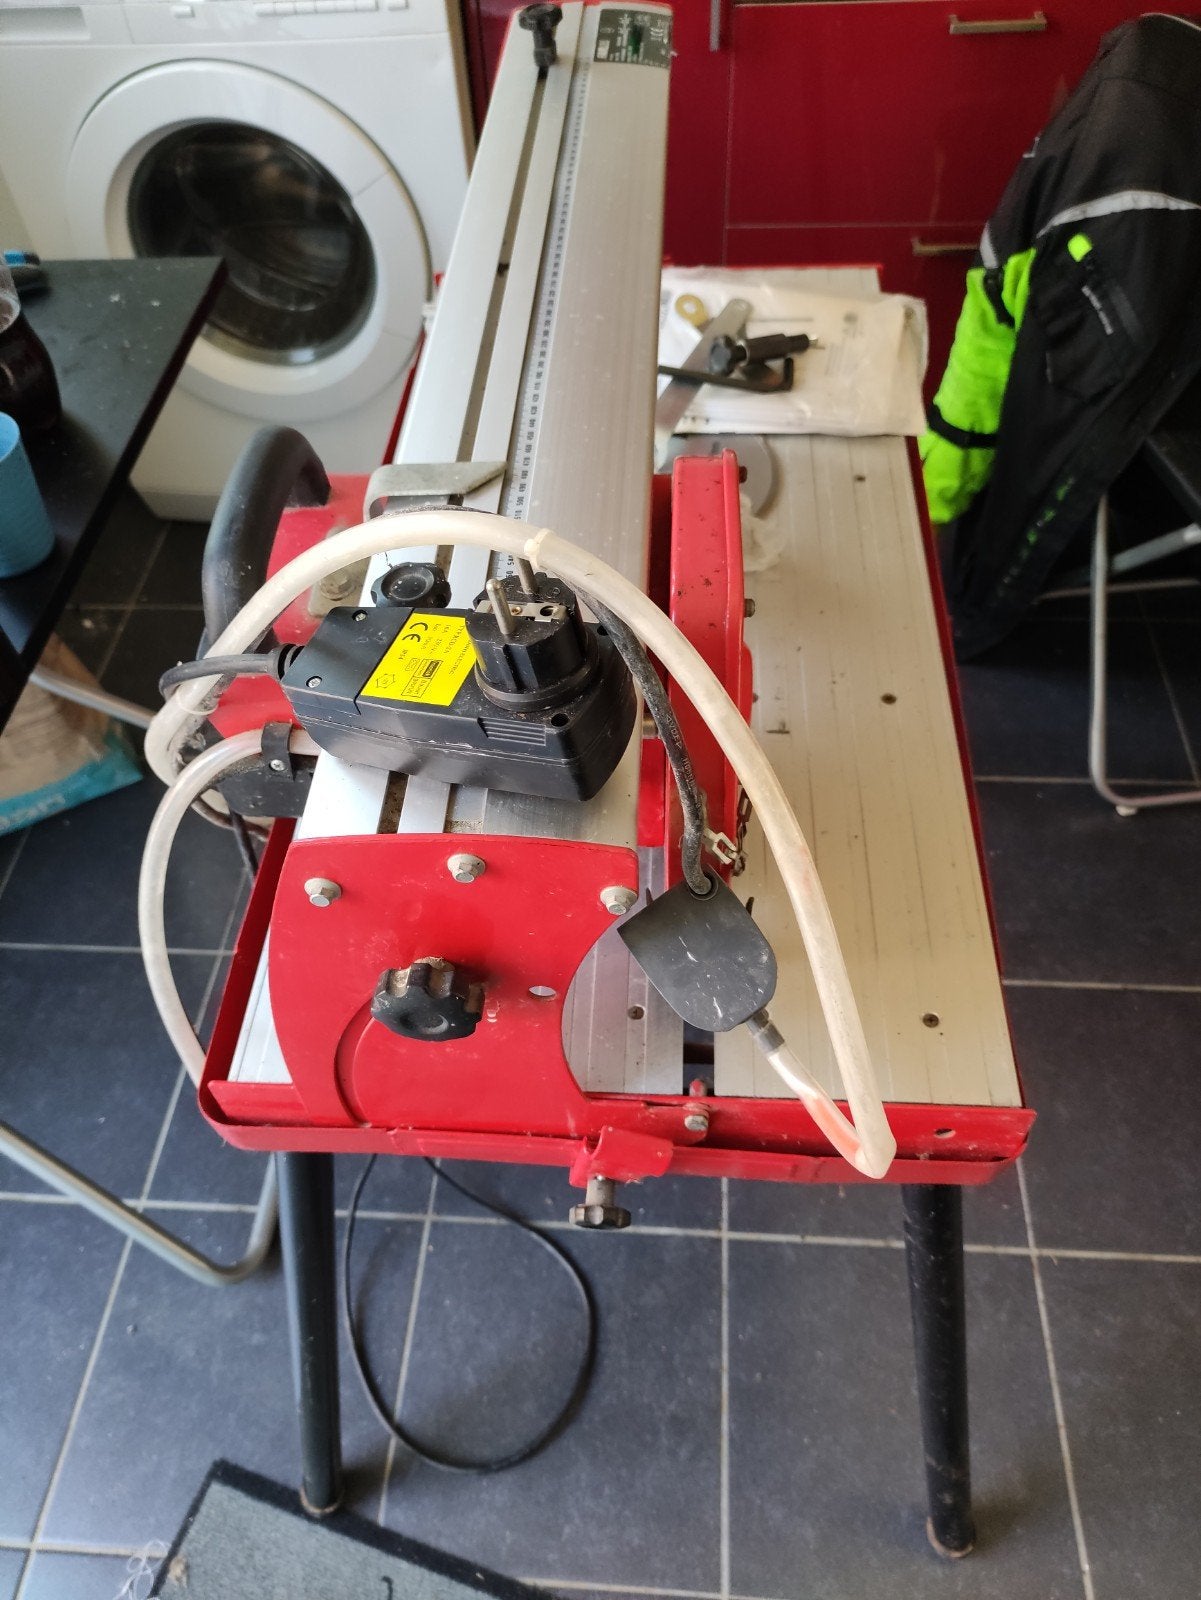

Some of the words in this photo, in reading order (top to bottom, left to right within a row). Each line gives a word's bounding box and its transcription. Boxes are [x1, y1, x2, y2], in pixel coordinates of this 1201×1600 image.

[520, 470, 528, 479] 480
[519, 483, 527, 492] 490
[516, 496, 524, 506] 500
[514, 510, 522, 519] 510
